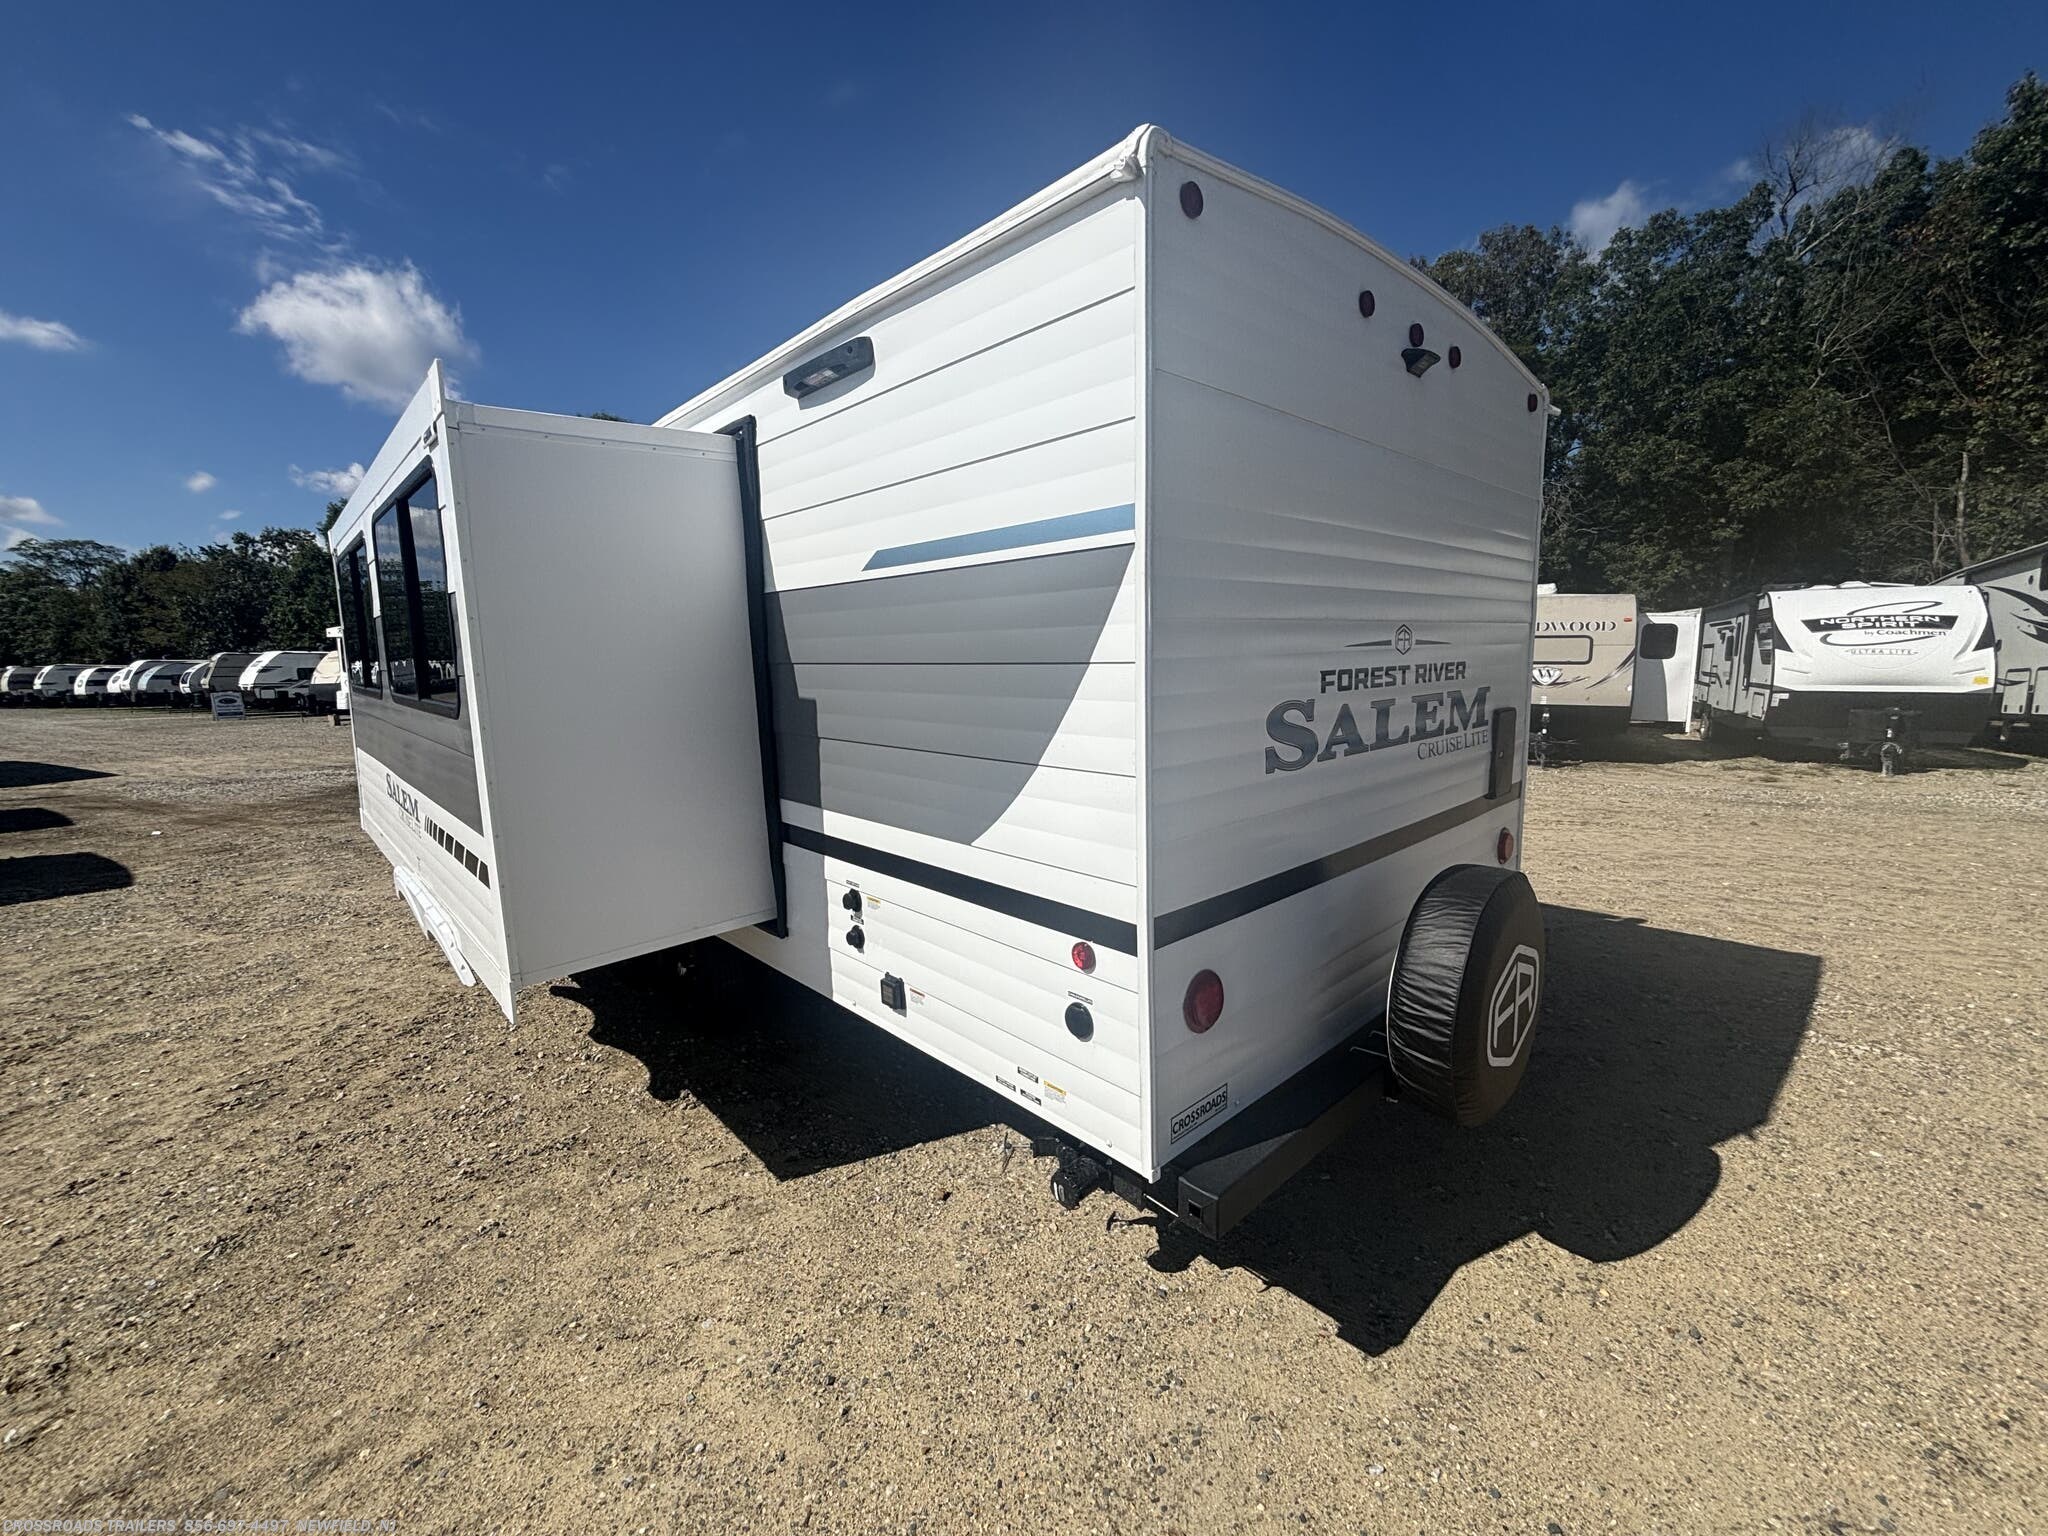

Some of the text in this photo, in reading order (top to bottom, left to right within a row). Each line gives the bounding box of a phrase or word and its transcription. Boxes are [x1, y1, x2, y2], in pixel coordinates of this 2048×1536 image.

[1536, 621, 1617, 632] DWOOD
[1820, 616, 1940, 625] NORTHERN
[1841, 621, 1920, 629] SPIRIT
[1320, 661, 1466, 694] FOREST RIVER
[1264, 686, 1491, 774] SALEM
[386, 773, 421, 823] SALEM
[1172, 1090, 1226, 1134] CROSSROADS
